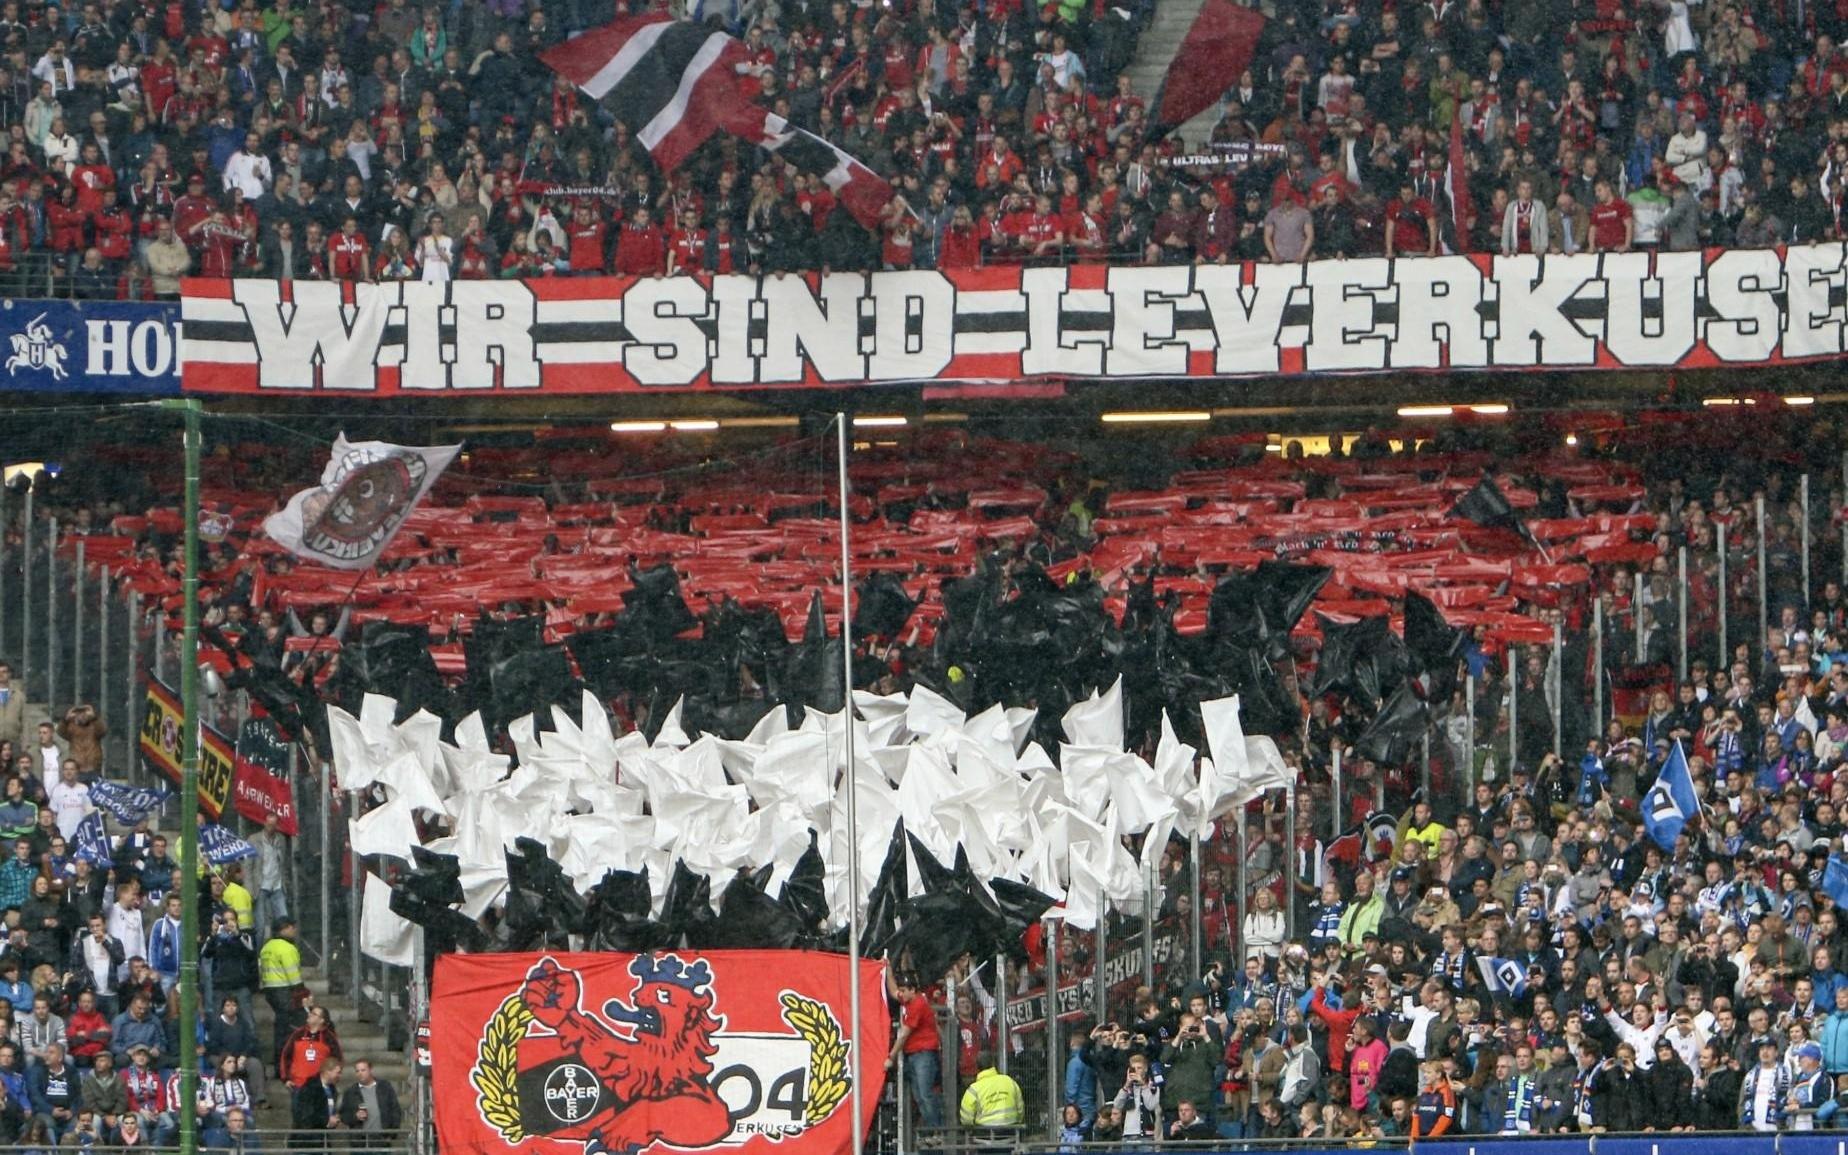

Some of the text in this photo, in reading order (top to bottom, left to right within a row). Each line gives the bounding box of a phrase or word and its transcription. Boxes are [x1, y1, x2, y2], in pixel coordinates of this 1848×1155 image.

[231, 242, 1848, 391] WIR SIND LEVERKUSE
[84, 319, 182, 378] HO
[1040, 989, 1078, 1017] BYS
[546, 1086, 597, 1099] BAYER
[564, 1067, 577, 1119] BAYER
[710, 1063, 809, 1121] 04
